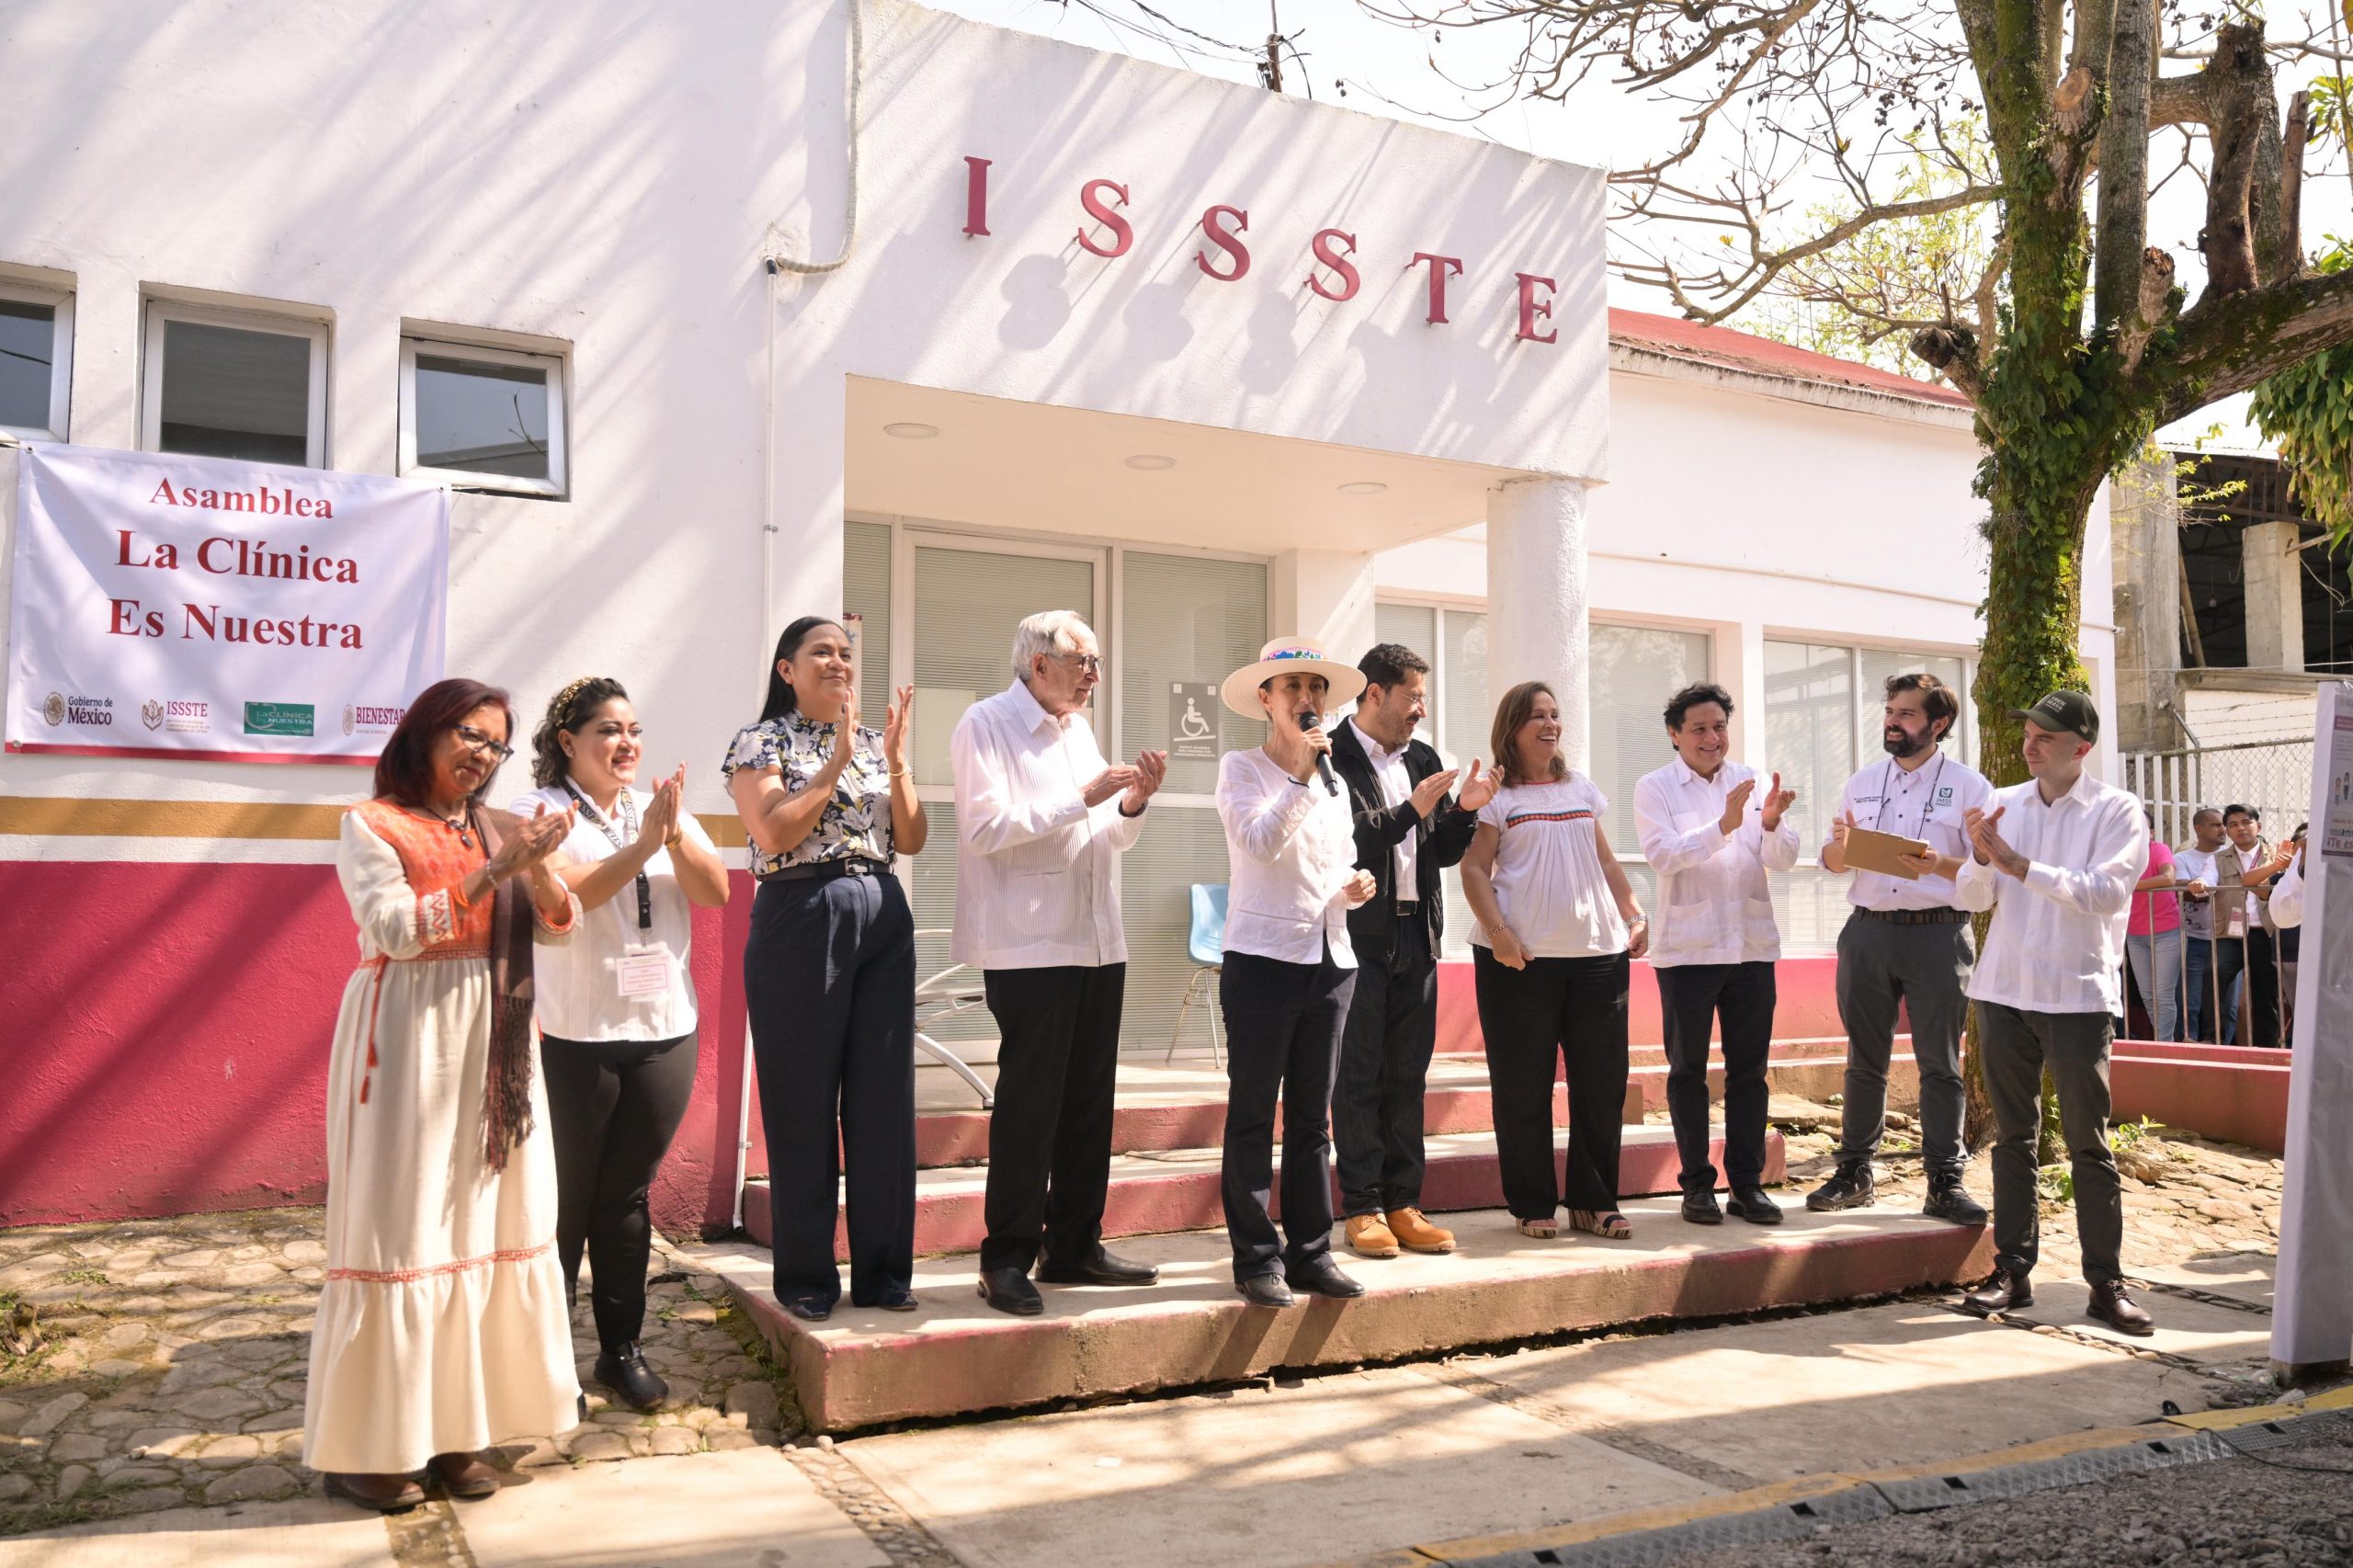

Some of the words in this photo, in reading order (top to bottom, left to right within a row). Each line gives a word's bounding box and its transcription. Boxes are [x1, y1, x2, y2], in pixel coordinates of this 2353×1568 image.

[962, 155, 1557, 345] ISSSTE
[149, 477, 333, 519] Asamblea
[115, 529, 179, 571] La
[197, 538, 359, 585] Clínica
[107, 599, 165, 638] Es
[180, 603, 363, 649] Nuestra
[68, 696, 102, 707] Gobierno
[104, 698, 113, 708] de
[68, 707, 112, 725] México
[166, 701, 208, 717] ISSSTE
